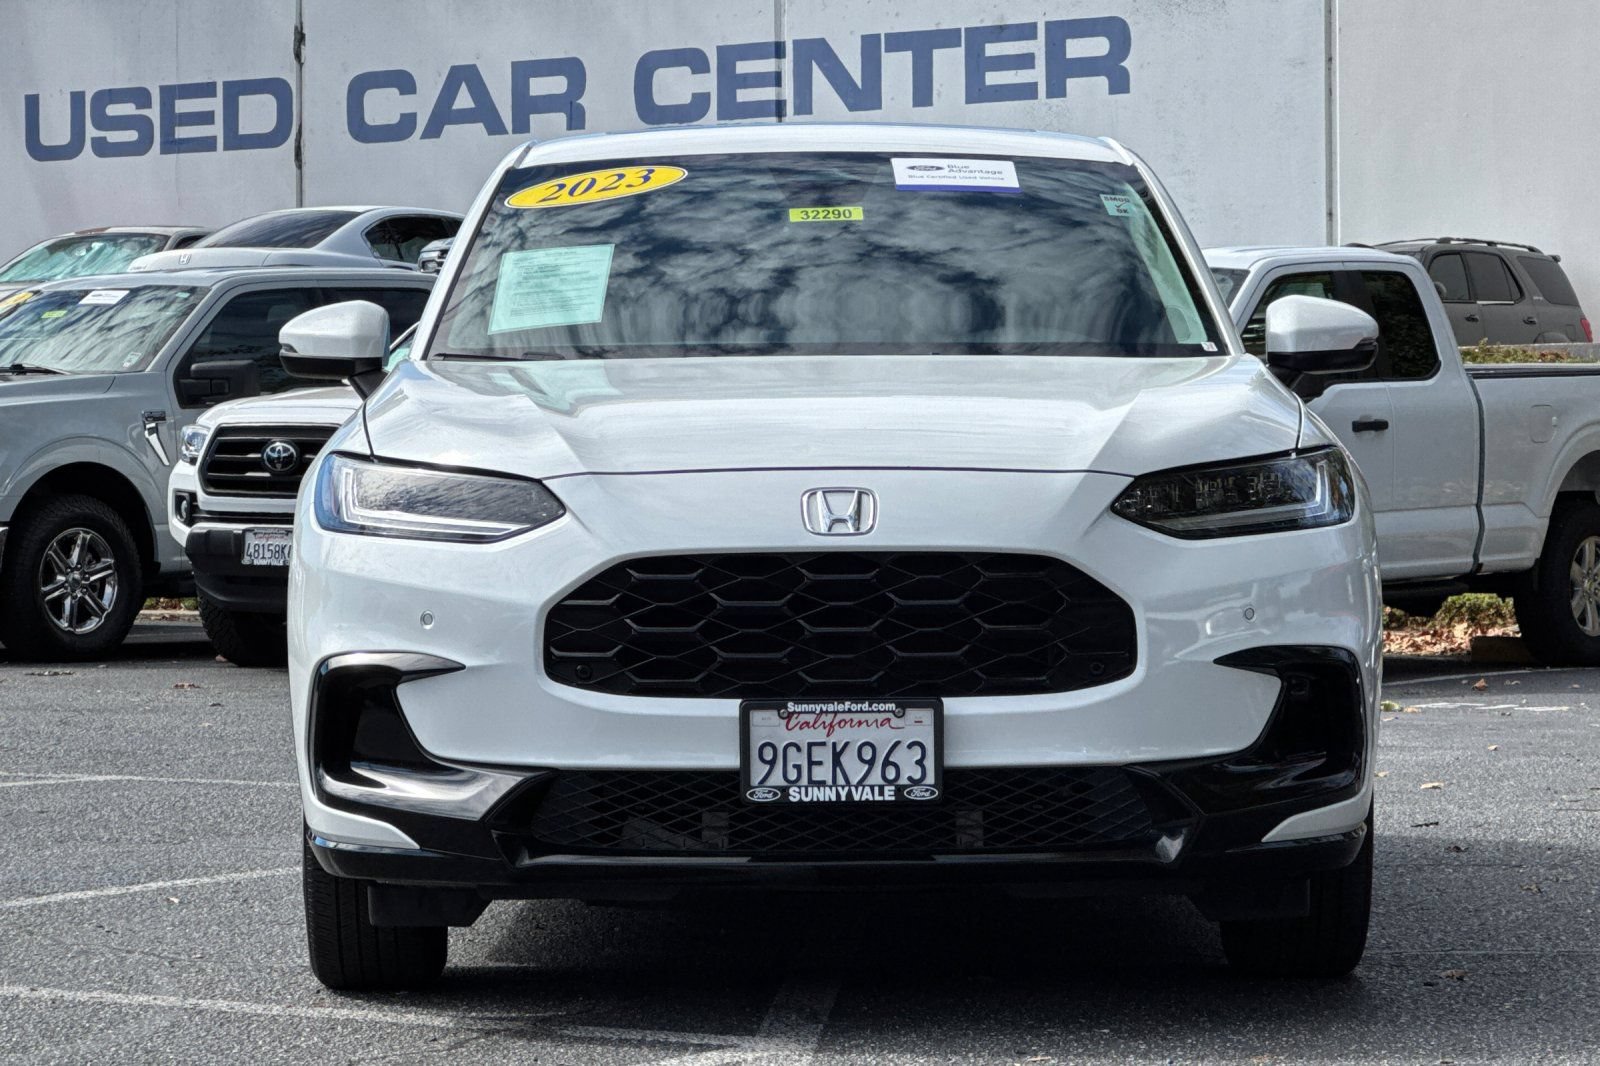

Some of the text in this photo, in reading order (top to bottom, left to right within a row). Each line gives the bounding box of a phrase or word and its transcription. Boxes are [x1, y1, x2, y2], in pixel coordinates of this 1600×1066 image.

[24, 15, 1132, 162] USED CAR CENTER
[536, 168, 656, 204] 2023
[800, 208, 853, 220] 32290
[787, 701, 896, 714] SunnyvaleFord.com
[785, 712, 905, 738] California
[757, 740, 927, 785] 9GEK963
[788, 786, 896, 802] SUNNYVALE
